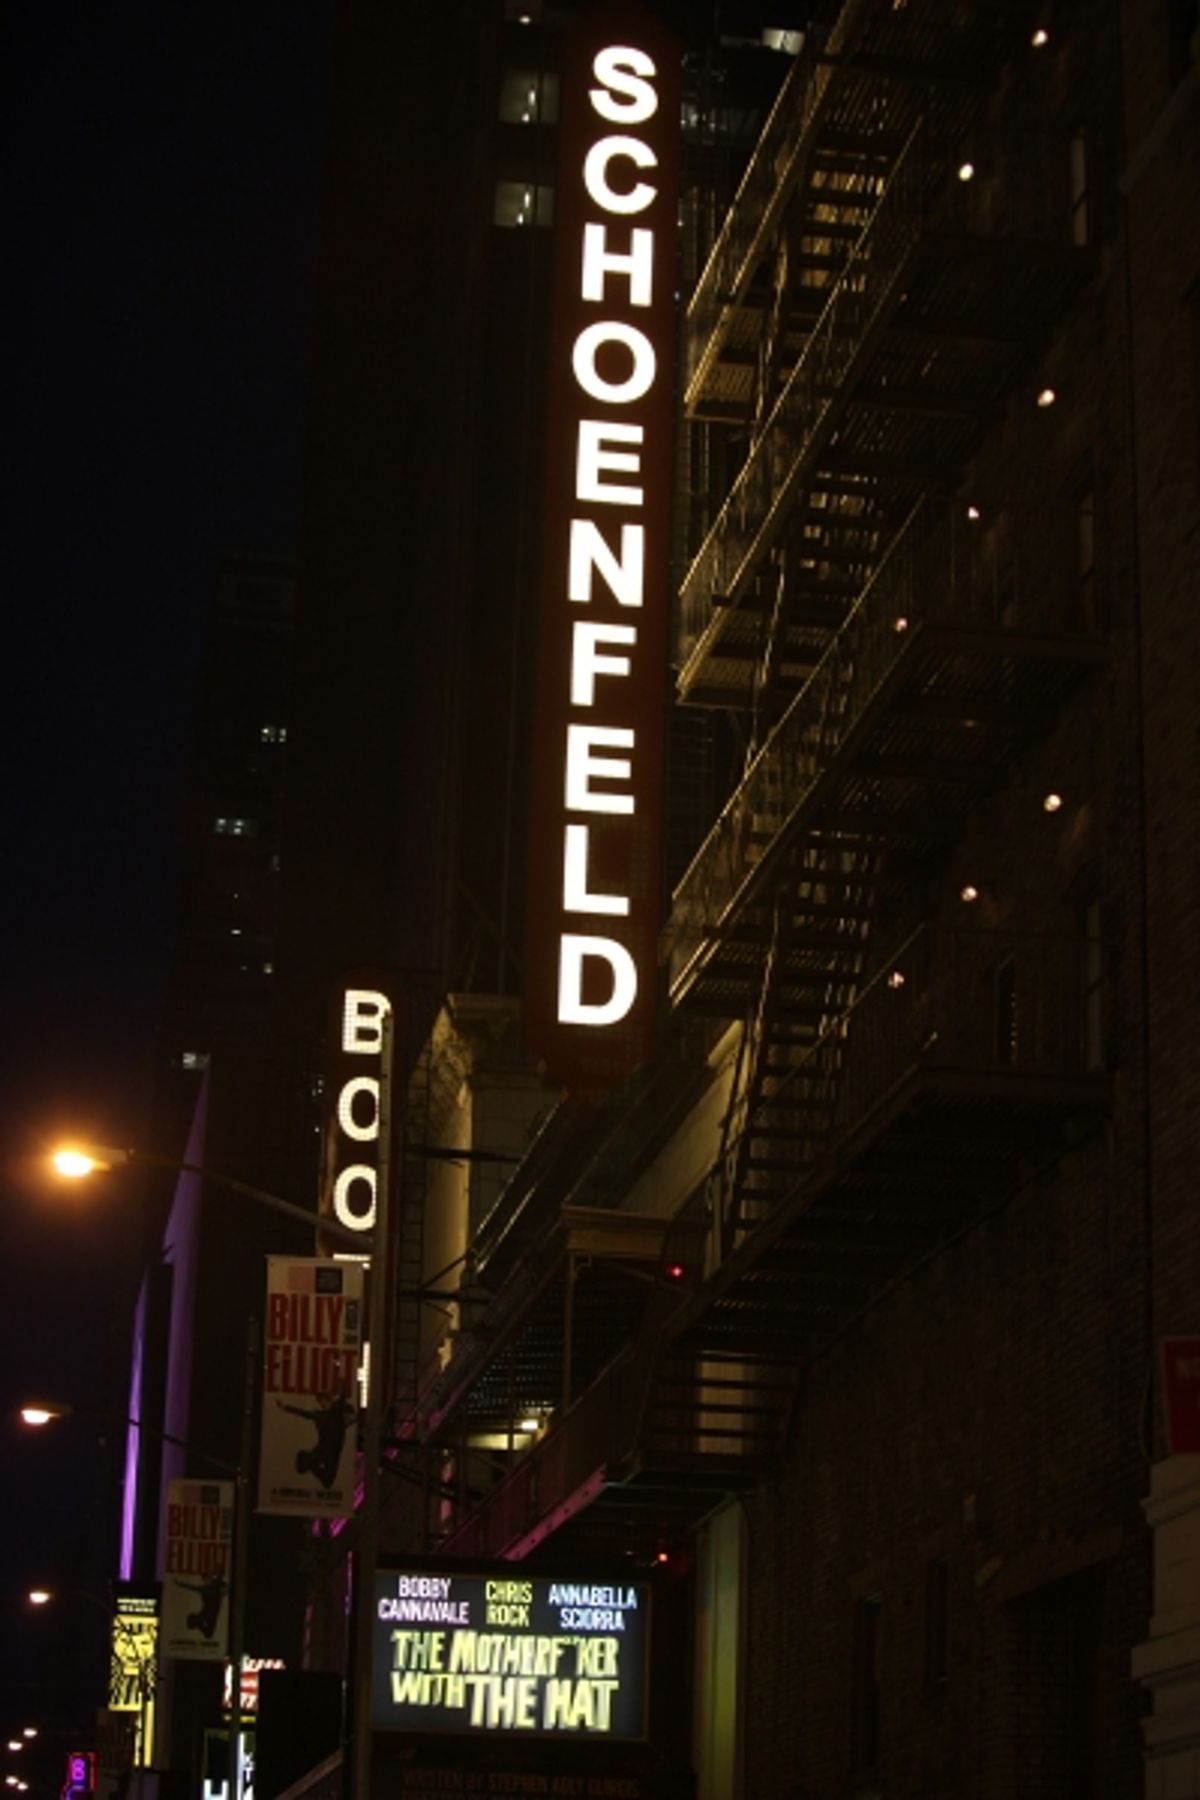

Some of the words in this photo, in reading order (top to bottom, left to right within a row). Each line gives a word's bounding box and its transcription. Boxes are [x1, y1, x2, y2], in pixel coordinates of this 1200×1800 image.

[556, 46, 658, 1026] SCHOENFELD
[332, 989, 392, 1409] BOO
[269, 1294, 344, 1345] BILLY
[266, 1344, 358, 1399] ELLIOT
[168, 1504, 222, 1540] BILLY
[398, 1575, 452, 1599] BOBBY
[485, 1580, 532, 1604] CHRIS
[549, 1583, 637, 1609] ANNABELLA
[378, 1599, 469, 1625] CANNAVALE
[486, 1604, 530, 1627] ROCK
[560, 1608, 625, 1631] SCIORRA
[390, 1629, 446, 1670] THE
[391, 1671, 465, 1709] WITH
[465, 1674, 538, 1729] THE
[543, 1678, 619, 1731] HAT
[487, 1772, 548, 1793] STEPHEN
